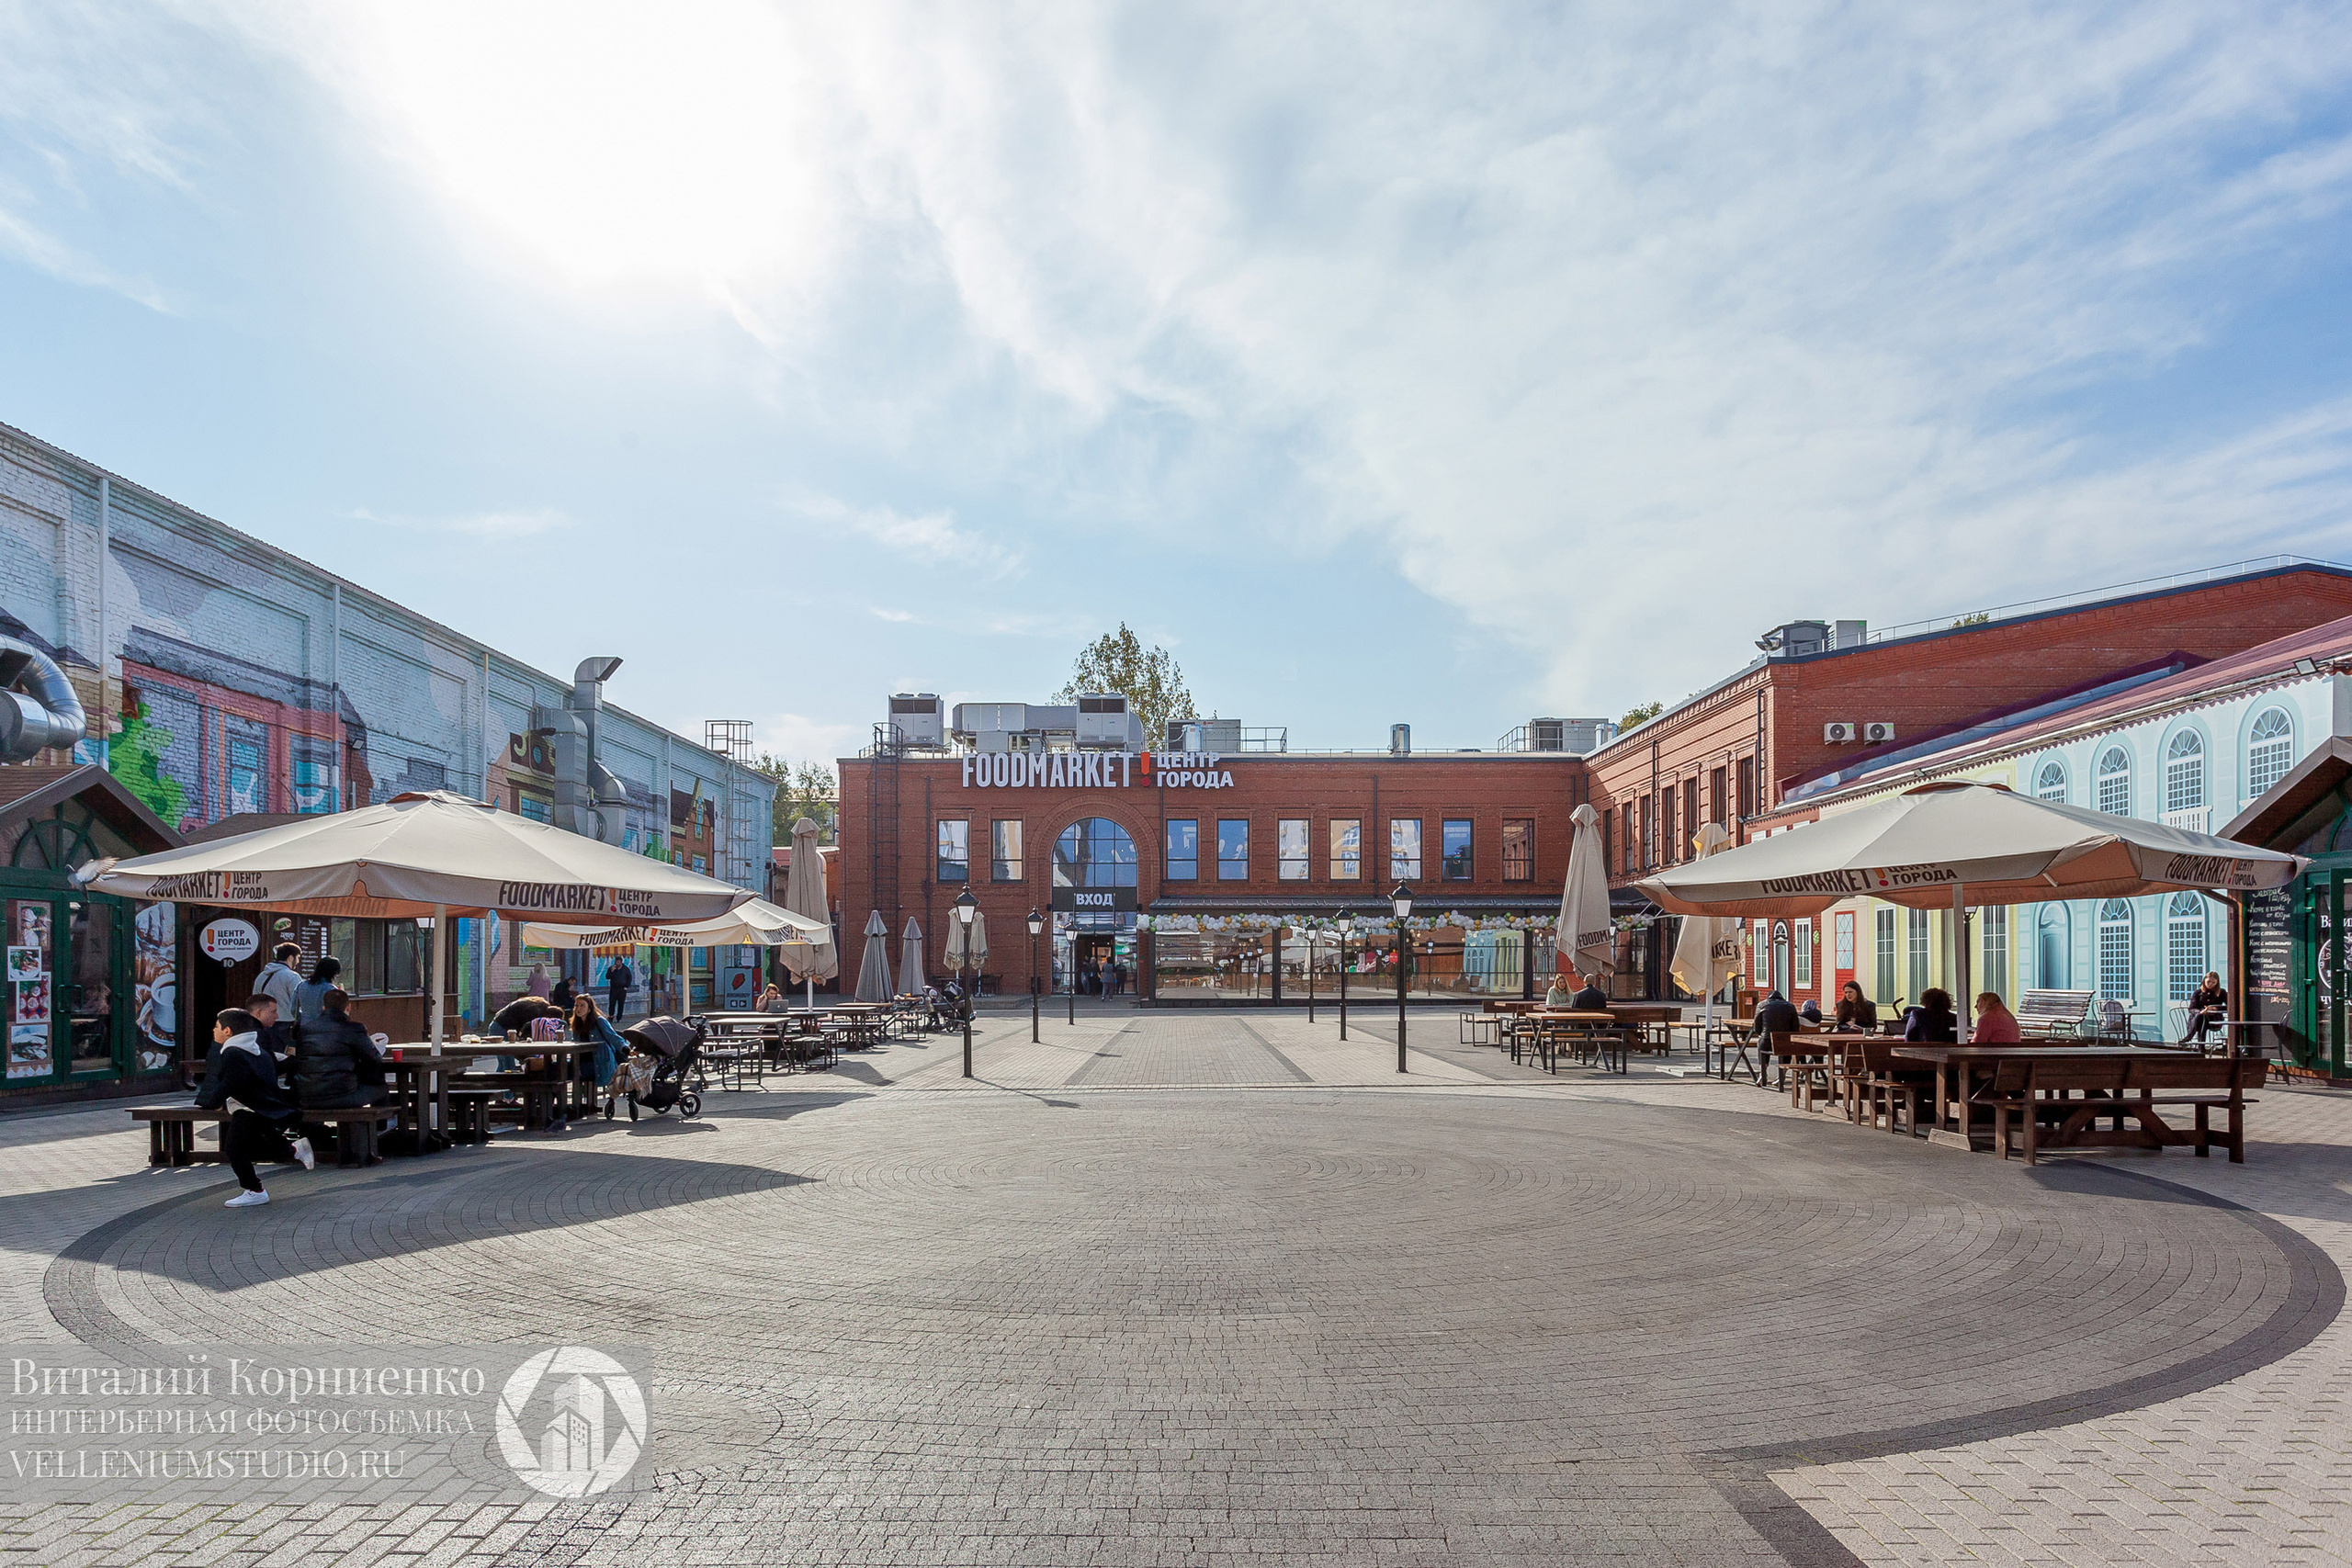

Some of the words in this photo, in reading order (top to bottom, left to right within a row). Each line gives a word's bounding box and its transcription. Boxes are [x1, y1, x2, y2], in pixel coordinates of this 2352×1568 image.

[1158, 751, 1220, 770] ЦЕНТР
[963, 752, 1134, 787] FOODMARKET
[1158, 771, 1234, 789] ГОРОДА
[233, 873, 262, 886] ЦЕНТР
[1892, 869, 1958, 886] ГОРОДА
[2232, 874, 2256, 886] ГОРОДА
[232, 887, 268, 900] ГОРОДА
[499, 881, 606, 910] FOODMARKET
[618, 889, 653, 902] ЦЕНТР
[1076, 894, 1113, 907] ВХОД
[619, 903, 661, 917] ГОРОДА
[217, 930, 244, 938] ЦЕНТР
[218, 938, 252, 946] ГОРОДА
[657, 937, 695, 945] ГОРОДА
